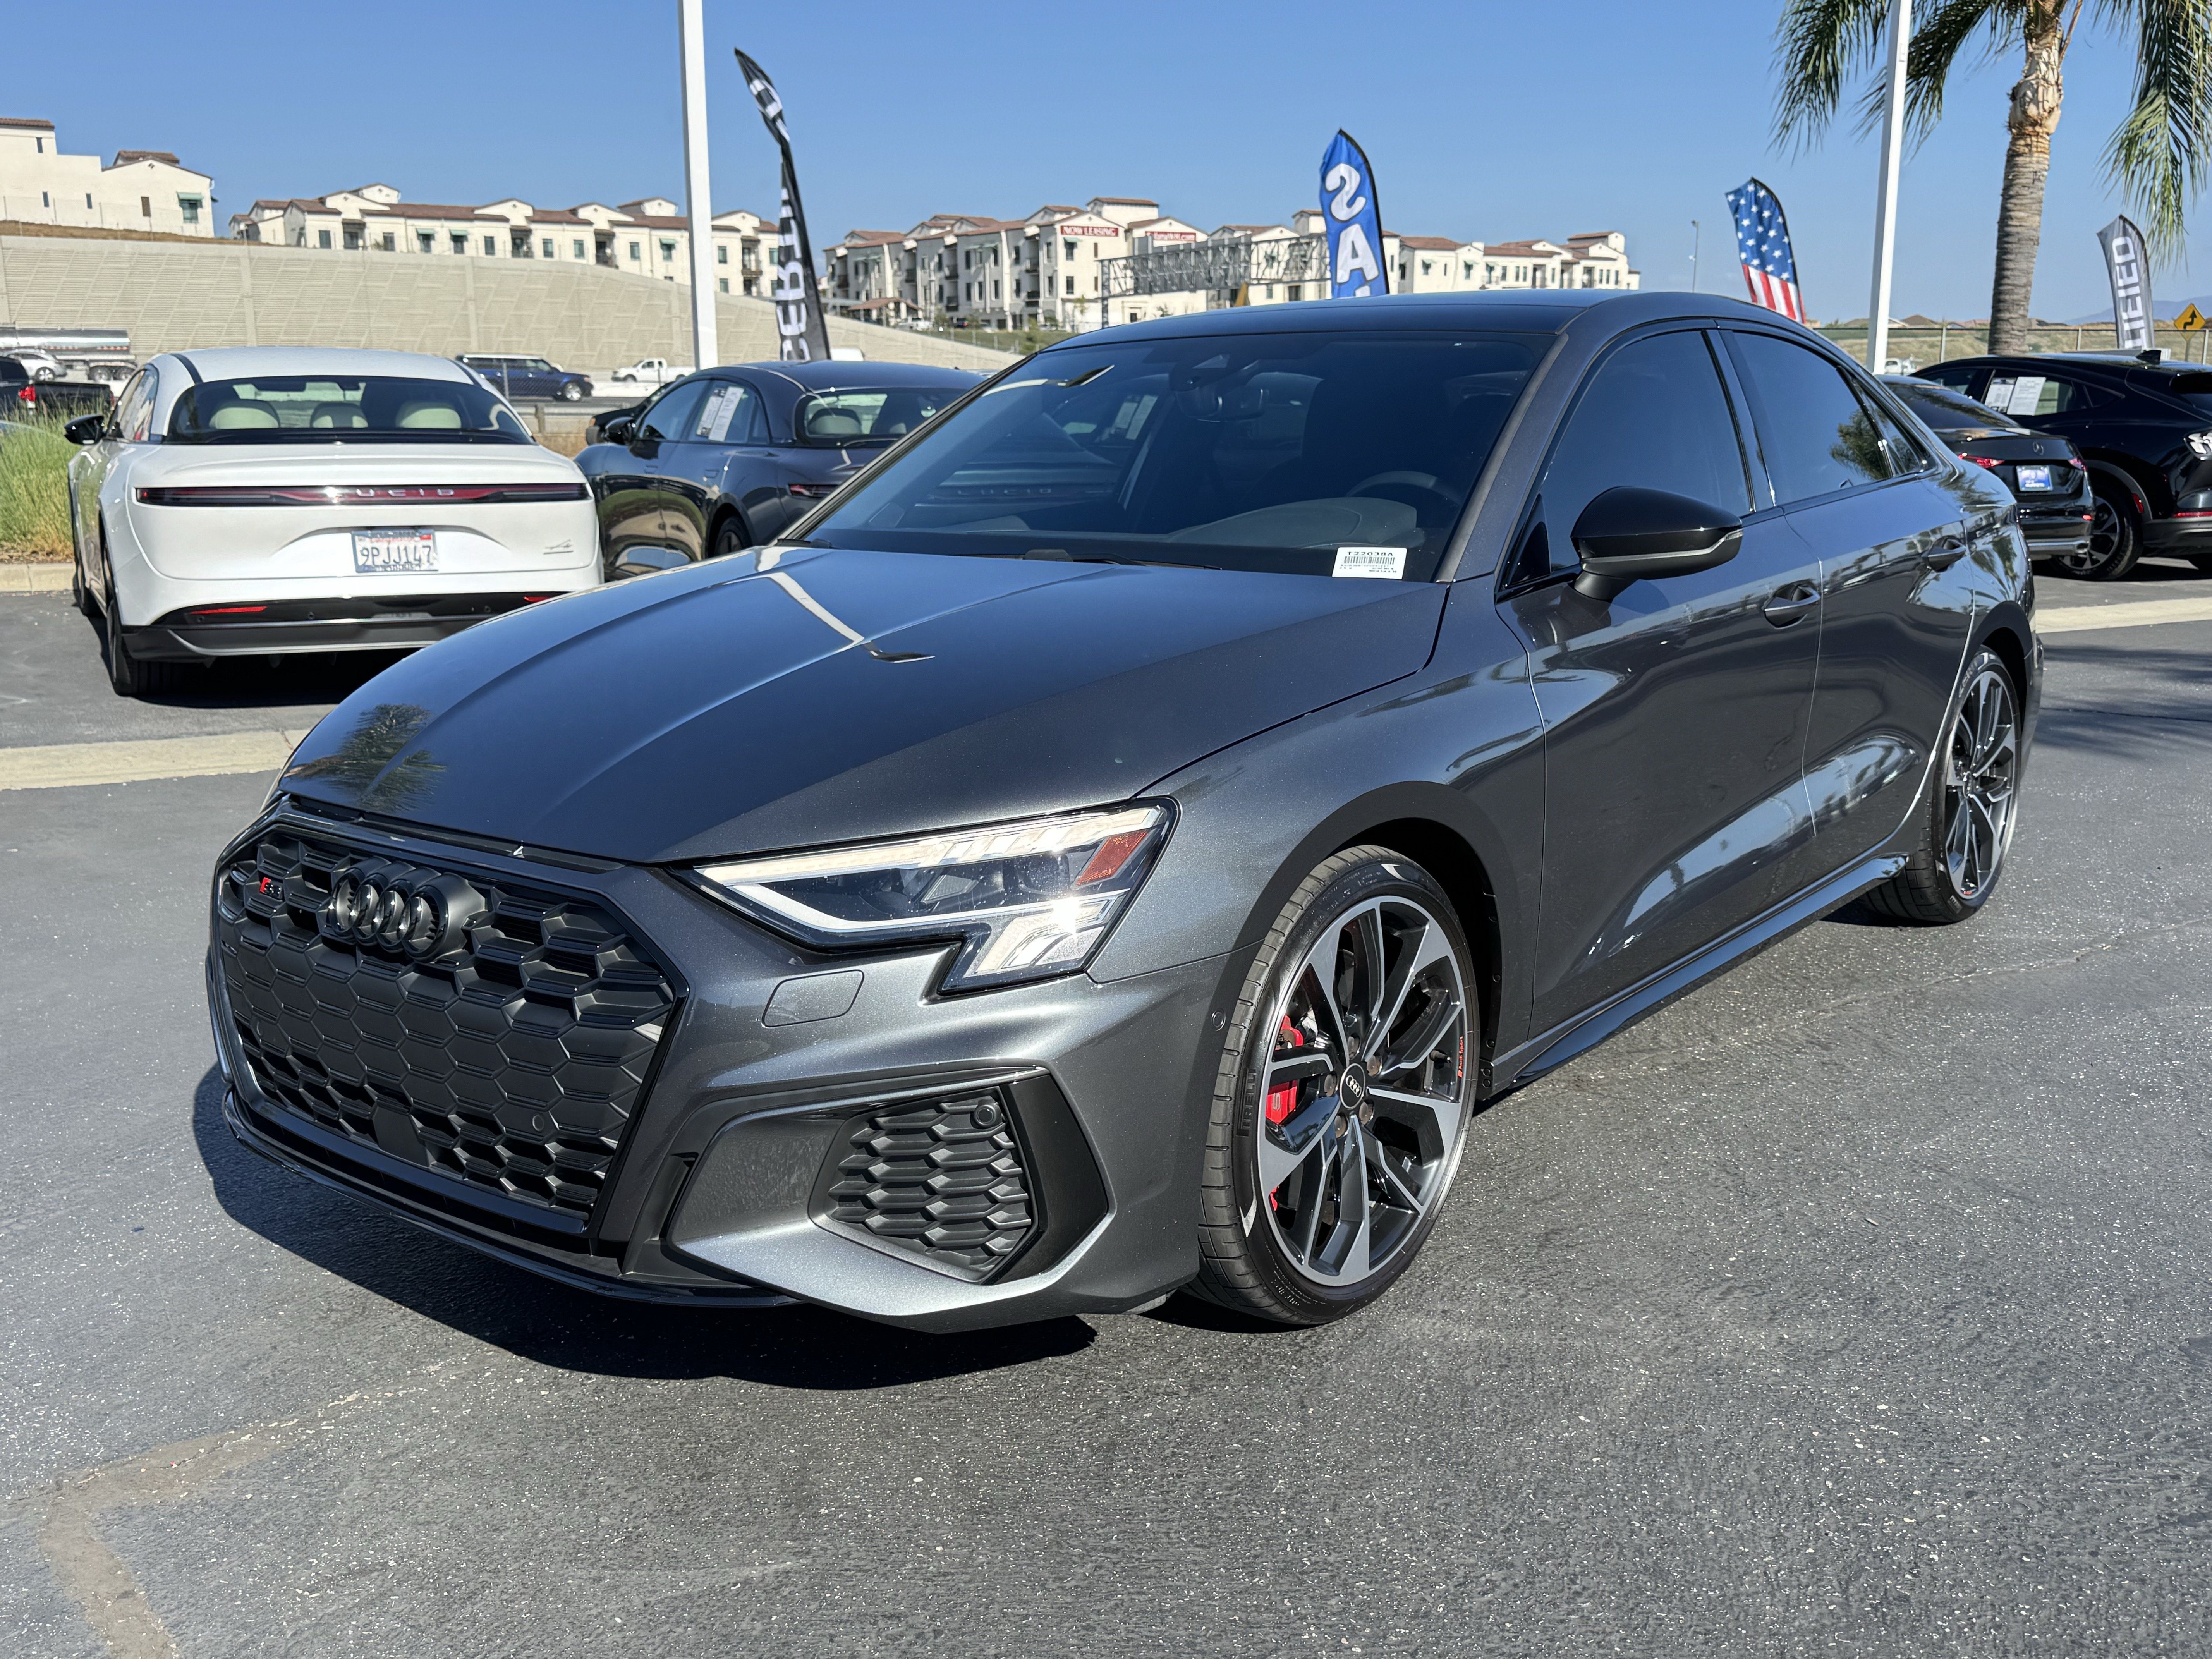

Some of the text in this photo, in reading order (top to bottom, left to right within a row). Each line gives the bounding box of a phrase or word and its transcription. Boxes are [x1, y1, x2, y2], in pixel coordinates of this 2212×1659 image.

[1063, 226, 1116, 237] NOW LEASING
[325, 488, 454, 496] UCID
[360, 545, 431, 566] 9PJJ147
